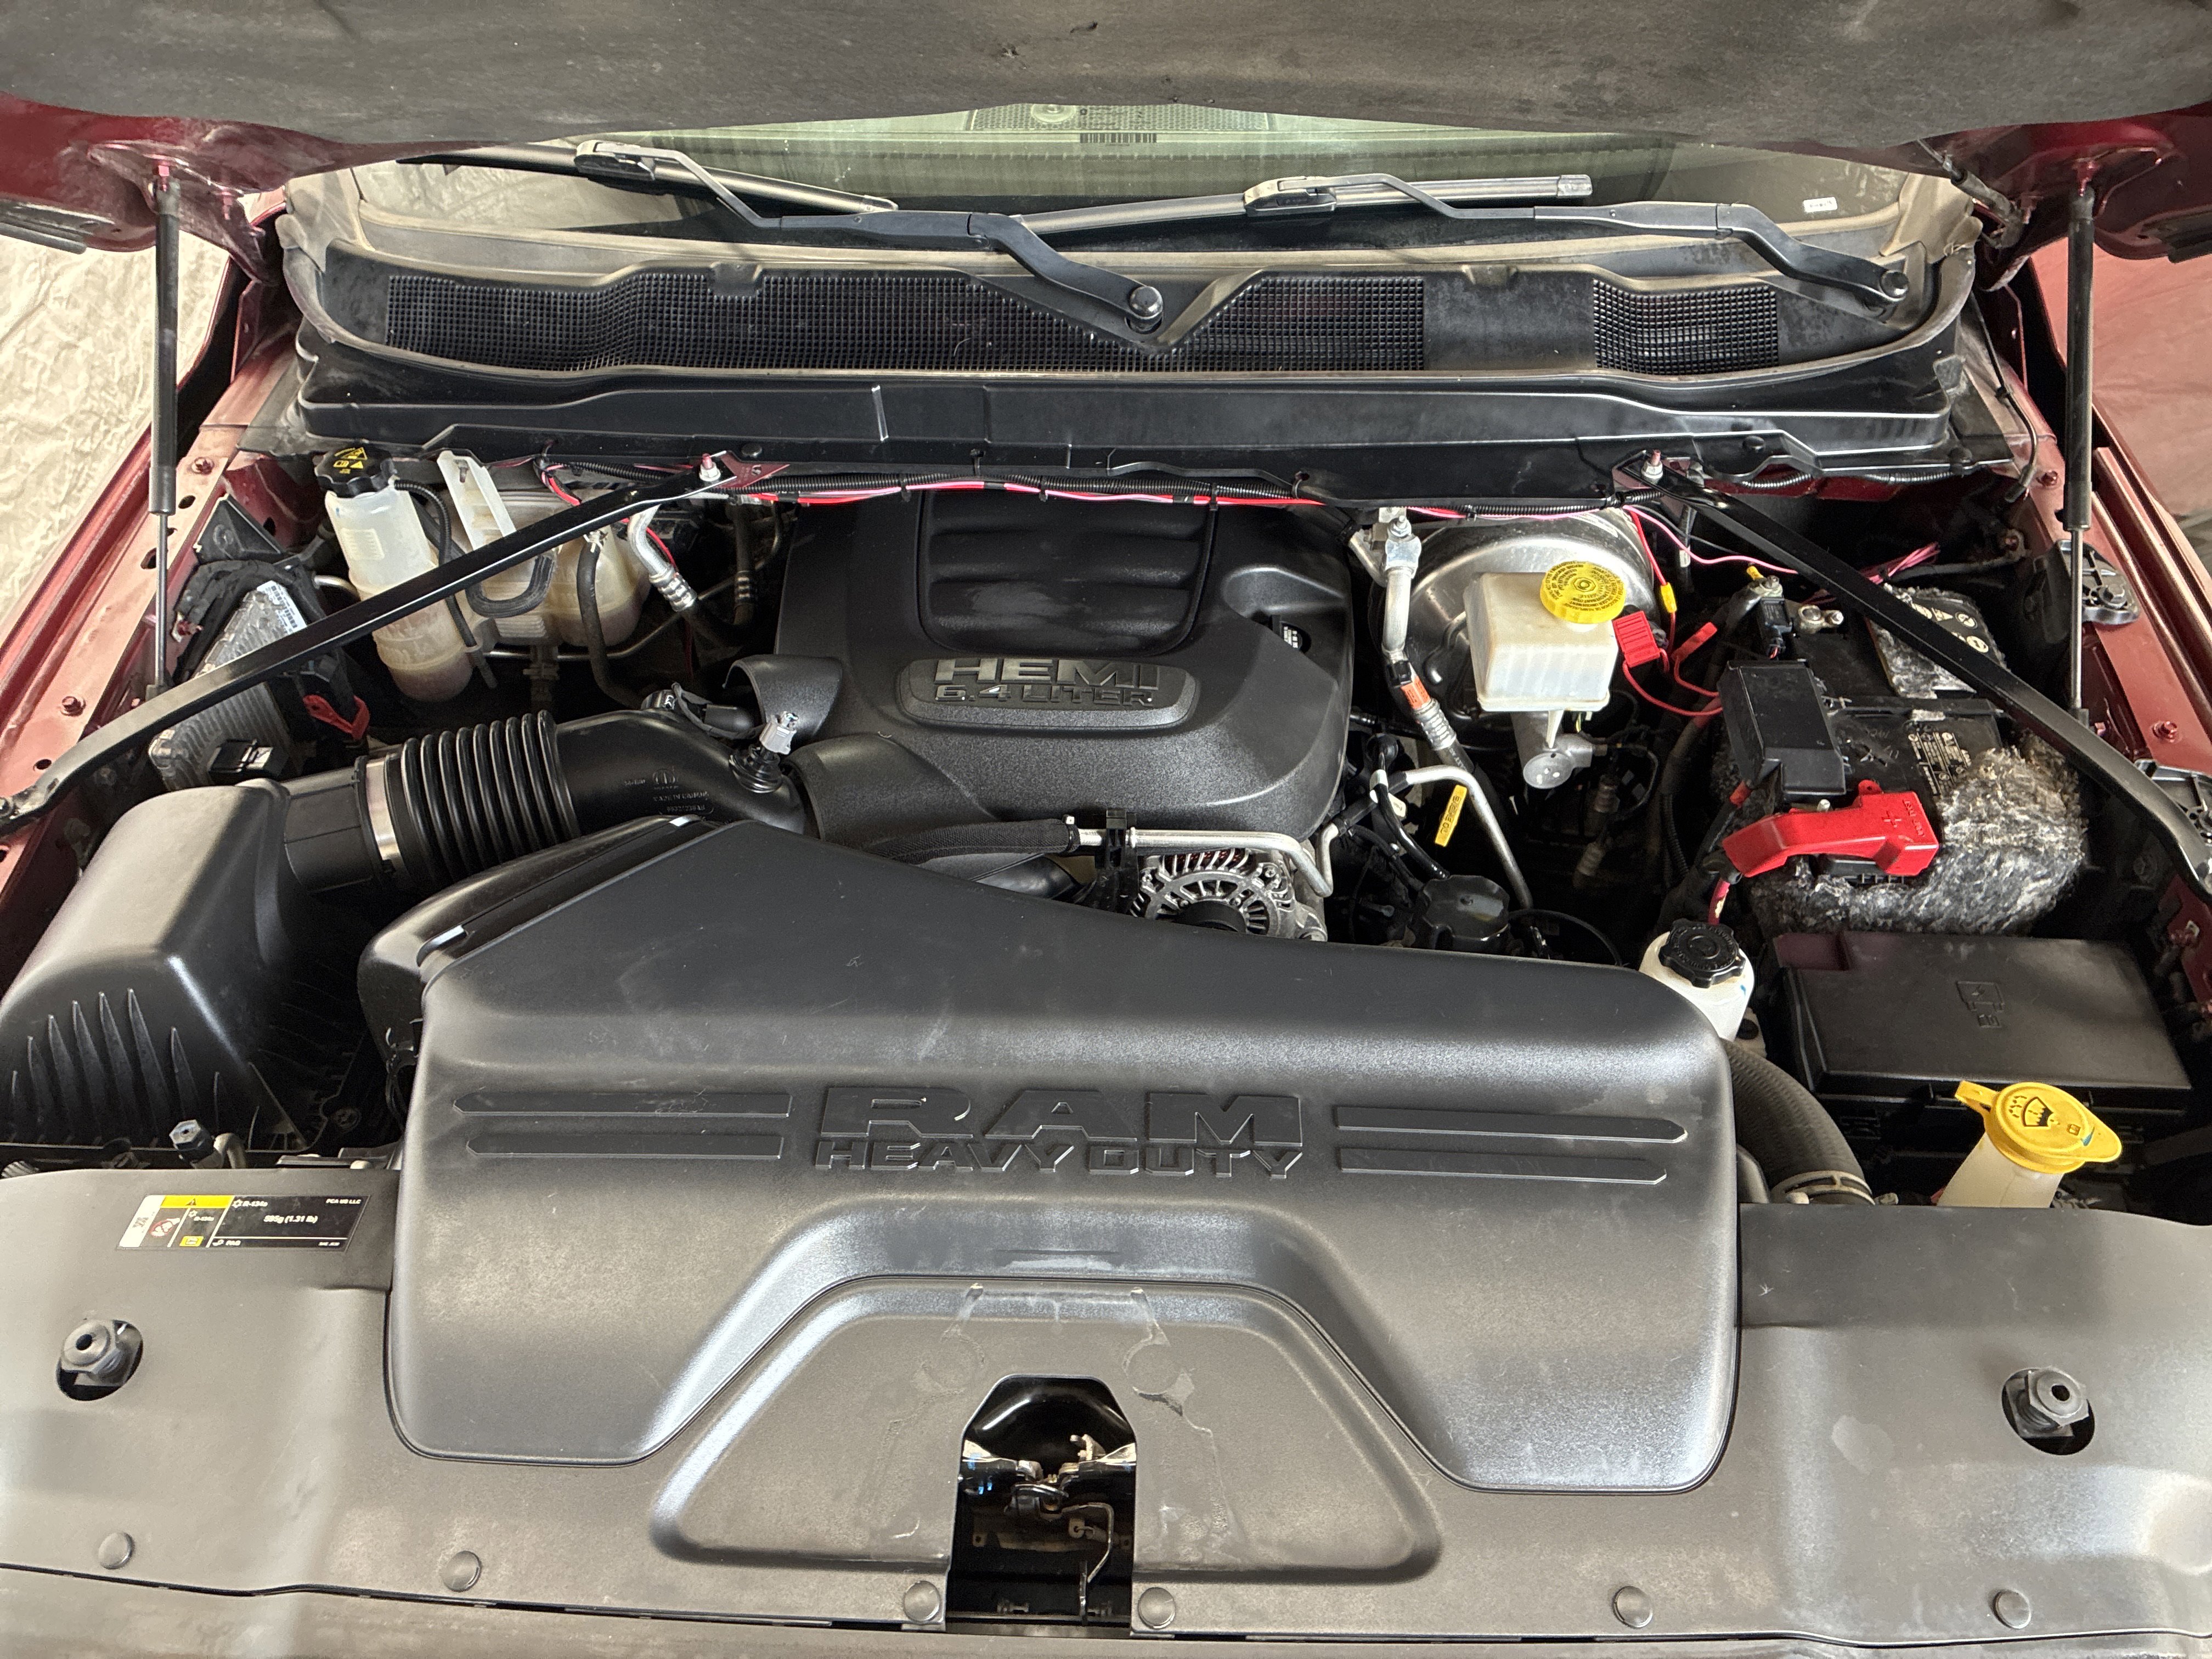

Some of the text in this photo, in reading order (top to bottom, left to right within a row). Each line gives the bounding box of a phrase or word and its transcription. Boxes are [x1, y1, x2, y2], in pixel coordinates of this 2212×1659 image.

[934, 657, 1160, 690] HEMI
[934, 684, 1154, 707] 6.4 LITER
[820, 1086, 1304, 1148] RAM
[815, 1140, 1304, 1179] HEAVY DUTY
